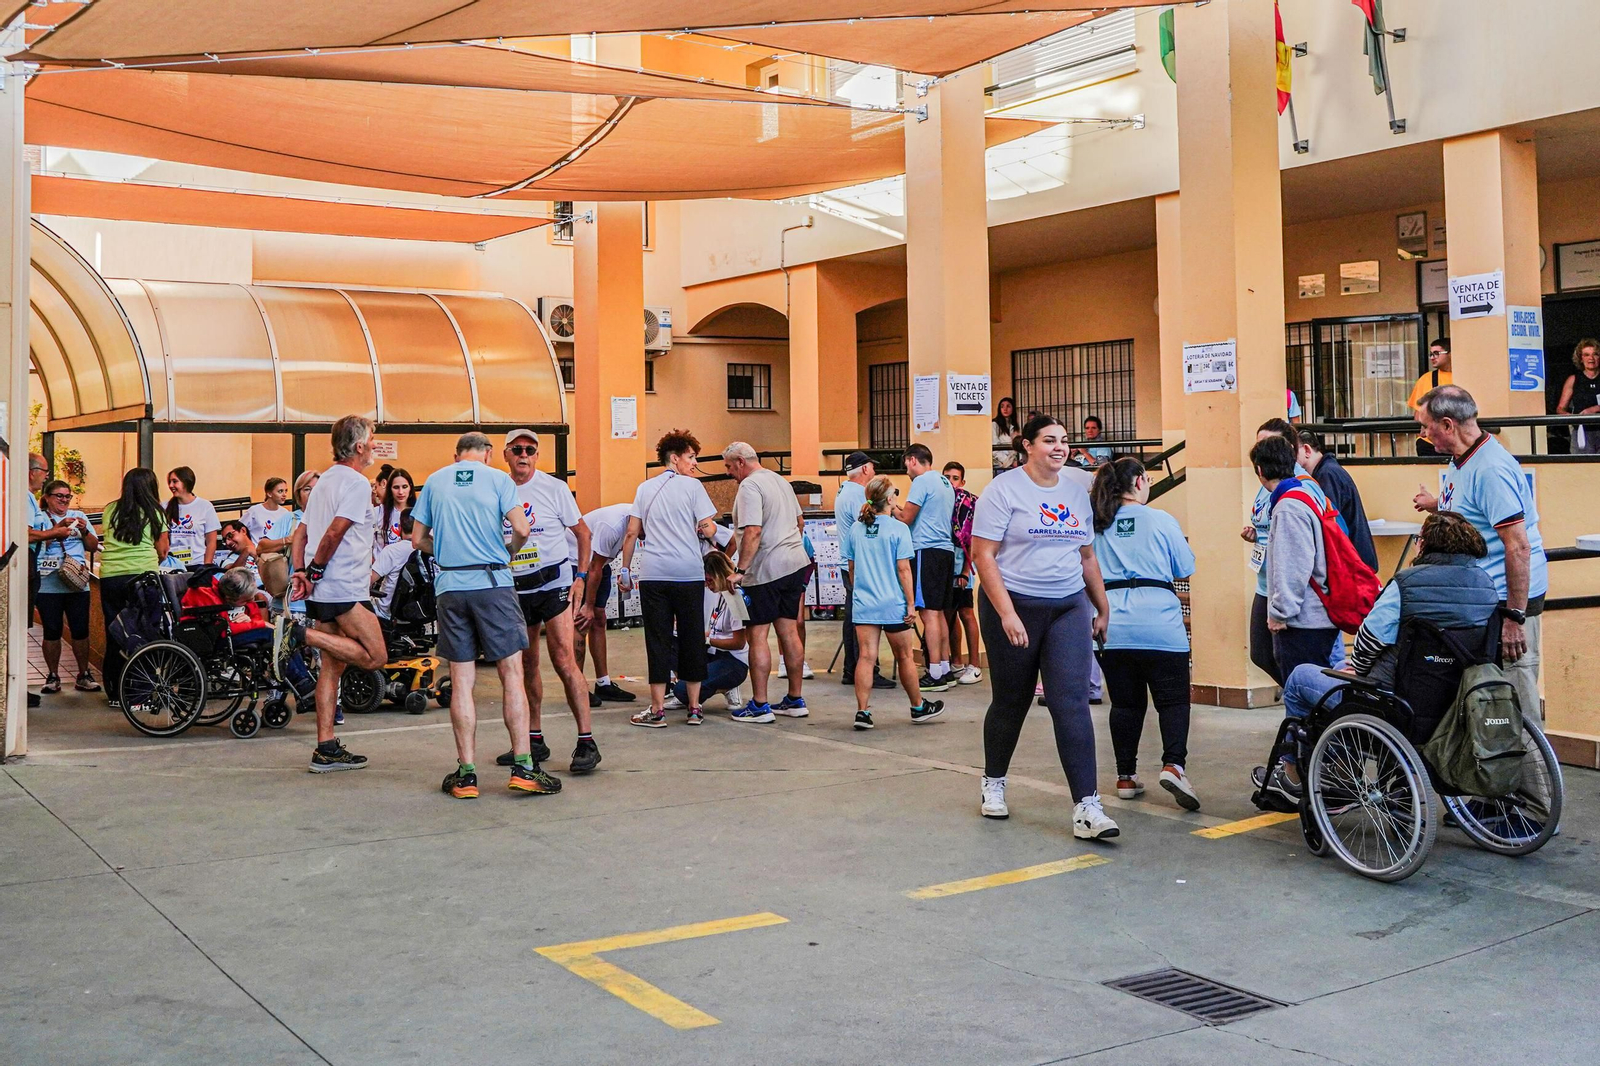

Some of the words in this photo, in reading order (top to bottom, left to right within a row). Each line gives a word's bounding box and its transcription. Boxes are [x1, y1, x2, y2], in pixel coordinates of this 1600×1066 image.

[1452, 282, 1484, 294] VENTA
[1486, 280, 1500, 290] DE
[1458, 292, 1496, 304] TICKETS
[950, 382, 978, 391] VENTA
[978, 382, 988, 391] DE
[954, 392, 985, 400] TICKETS
[514, 552, 538, 561] UNTARIO
[1434, 656, 1454, 664] Breezy
[1484, 717, 1510, 726] Joma
